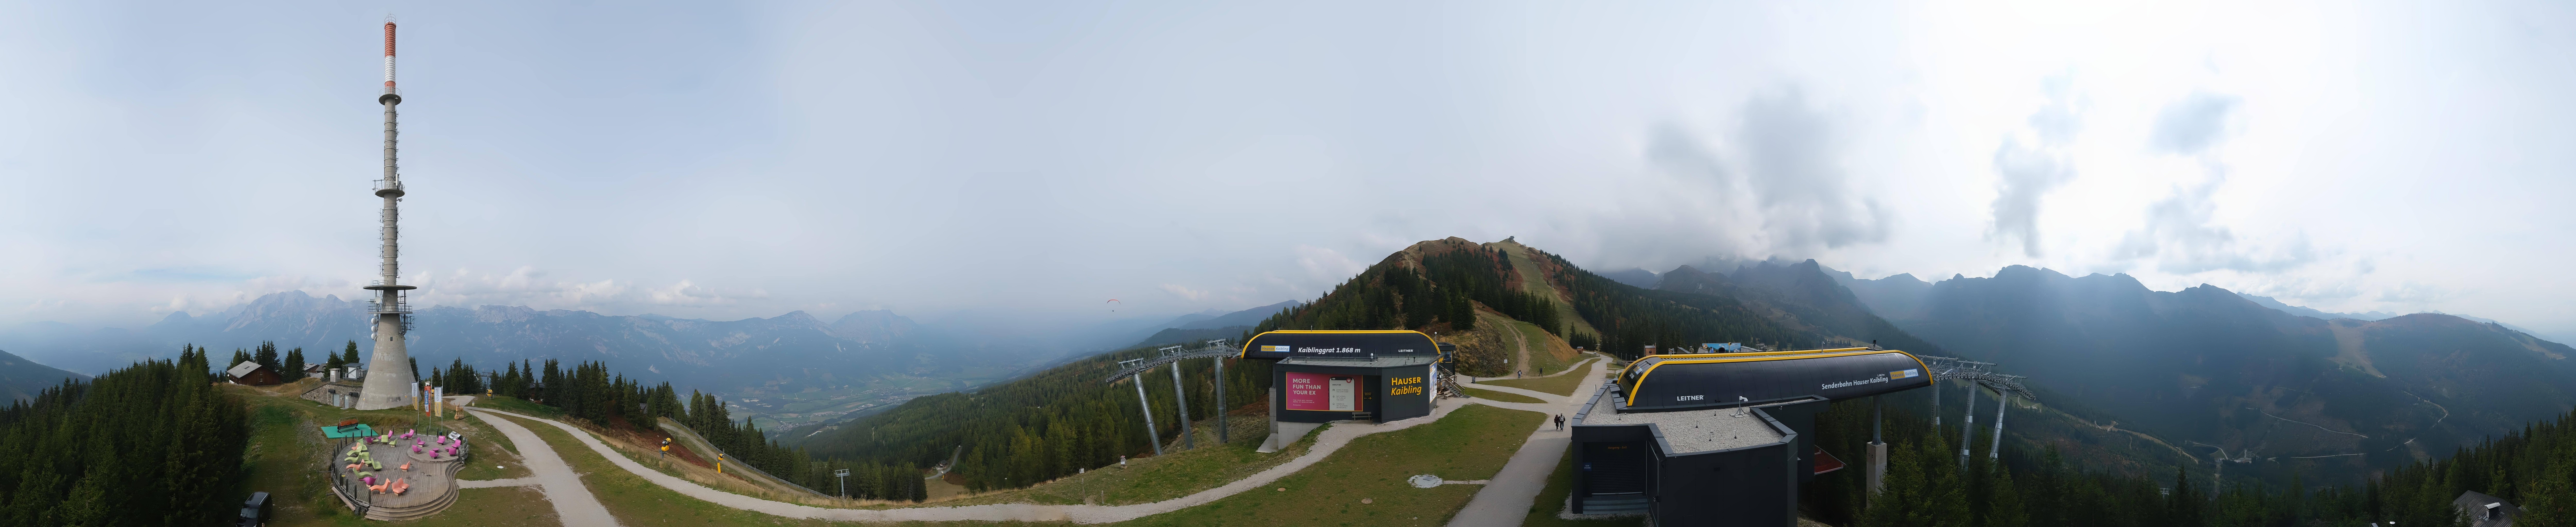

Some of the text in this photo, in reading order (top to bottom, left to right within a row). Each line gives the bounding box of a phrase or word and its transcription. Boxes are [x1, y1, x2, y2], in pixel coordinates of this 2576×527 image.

[1392, 377, 1421, 386] HAUSER
[1822, 381, 1852, 389] Senderbahn
[1391, 386, 1422, 396] Kaibling
